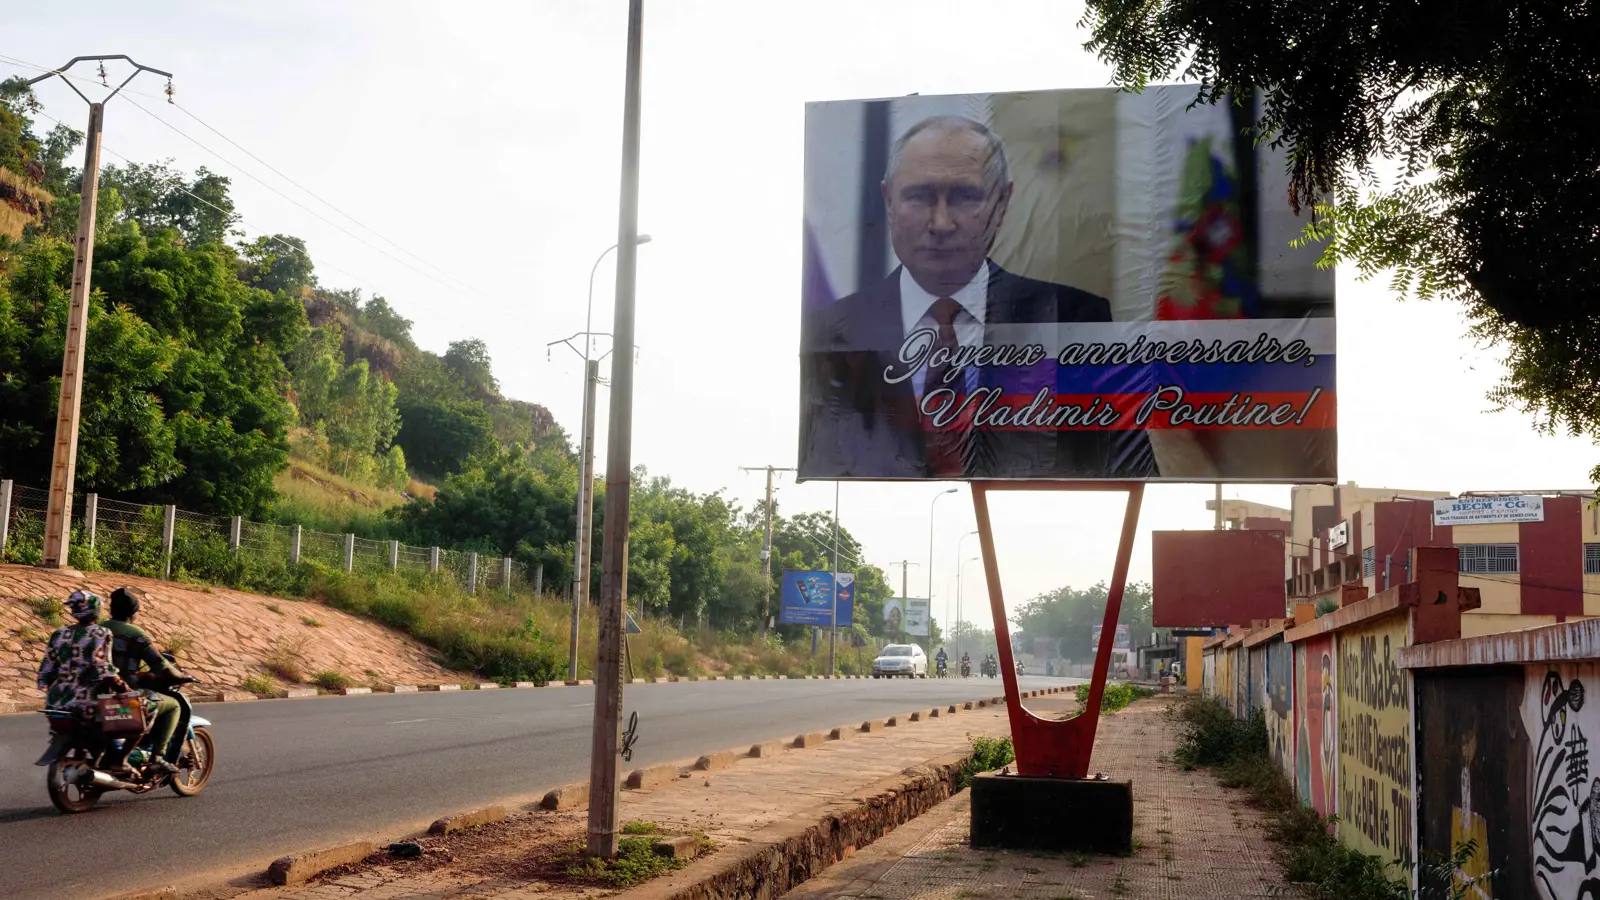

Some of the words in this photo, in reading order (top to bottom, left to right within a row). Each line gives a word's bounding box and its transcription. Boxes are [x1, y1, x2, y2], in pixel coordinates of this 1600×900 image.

[883, 328, 1047, 384] Joyeux
[1059, 332, 1316, 367] anniversaire,
[920, 387, 1120, 428] Vladimir
[1135, 385, 1322, 426] Poutine!
[1452, 502, 1493, 511] BECM
[1505, 501, 1526, 509] CG
[1458, 496, 1520, 504] ENTREPRISES
[1373, 717, 1411, 791] Démocrati
[1362, 775, 1379, 848] BIEN
[1380, 781, 1390, 850] de
